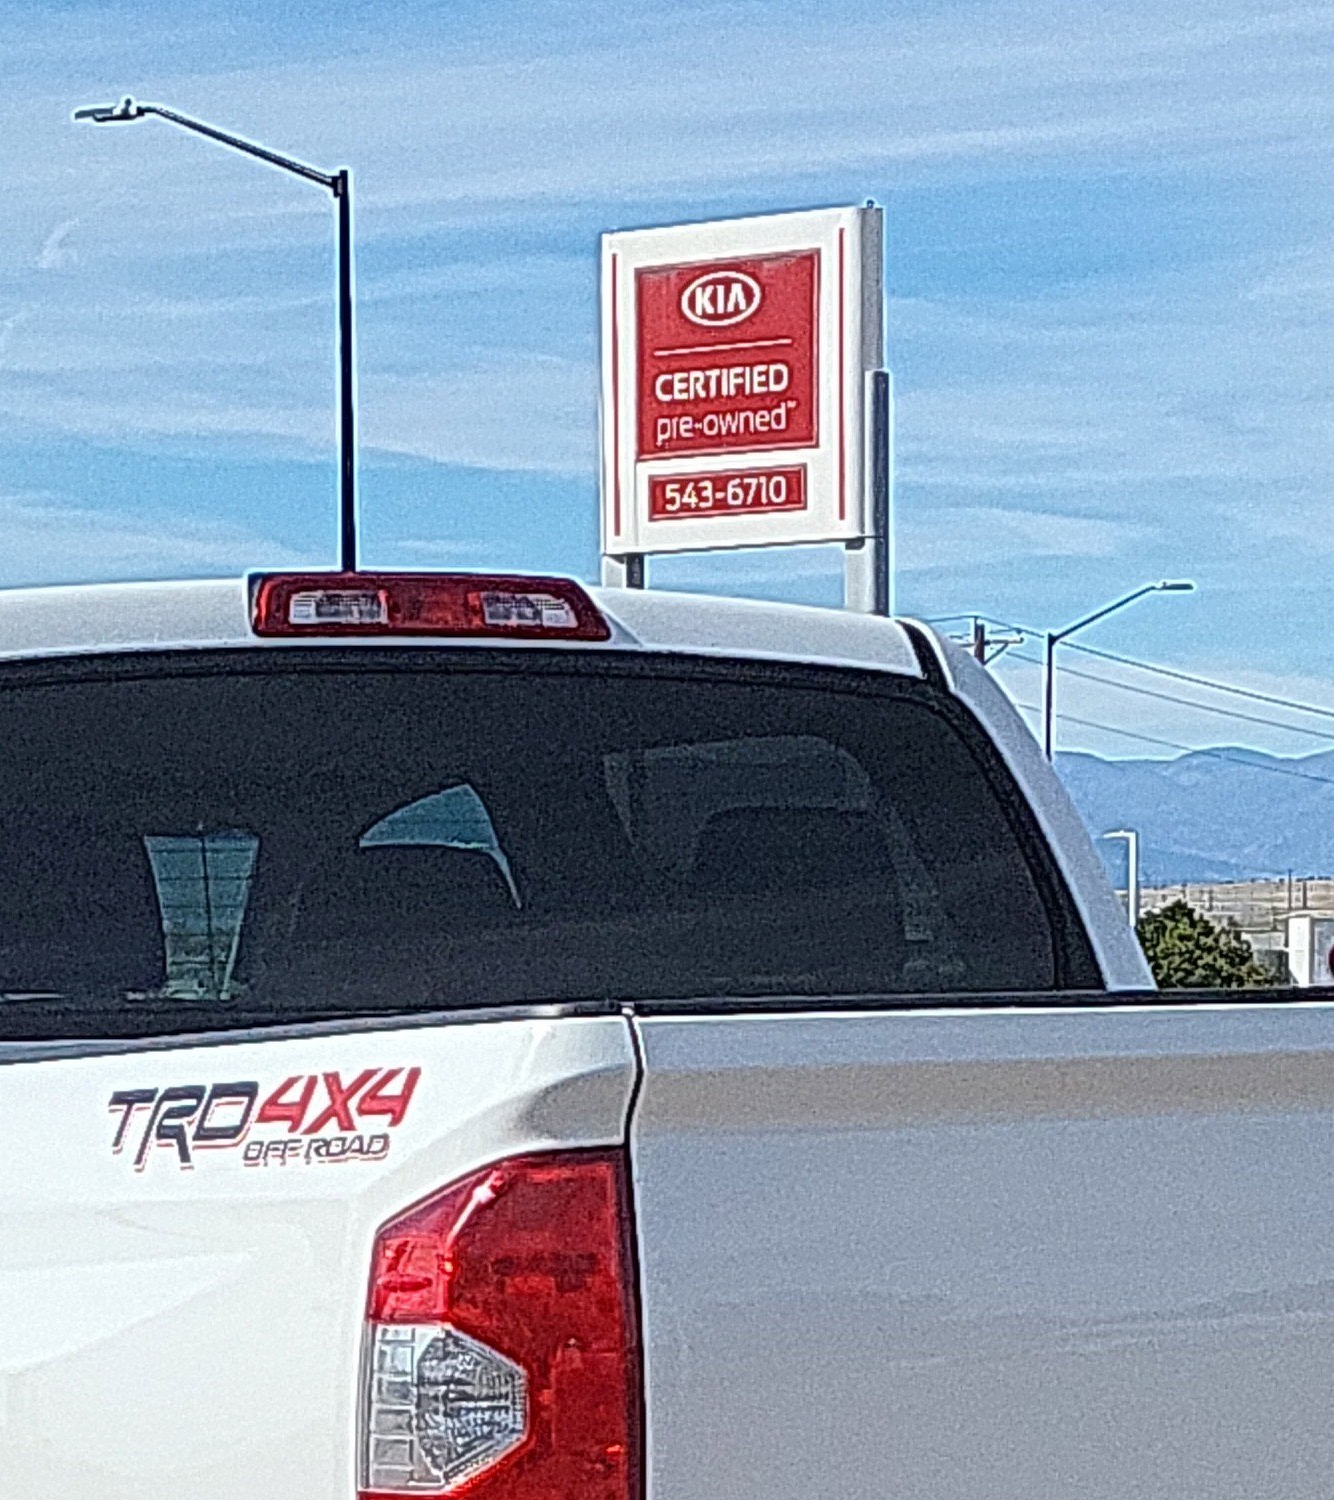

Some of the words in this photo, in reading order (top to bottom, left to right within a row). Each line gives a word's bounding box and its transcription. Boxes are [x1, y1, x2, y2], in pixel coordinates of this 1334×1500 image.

[694, 283, 747, 317] KIA
[654, 363, 789, 402] CERTIFIED
[665, 475, 788, 512] 543-6710
[108, 1080, 259, 1172] TRD
